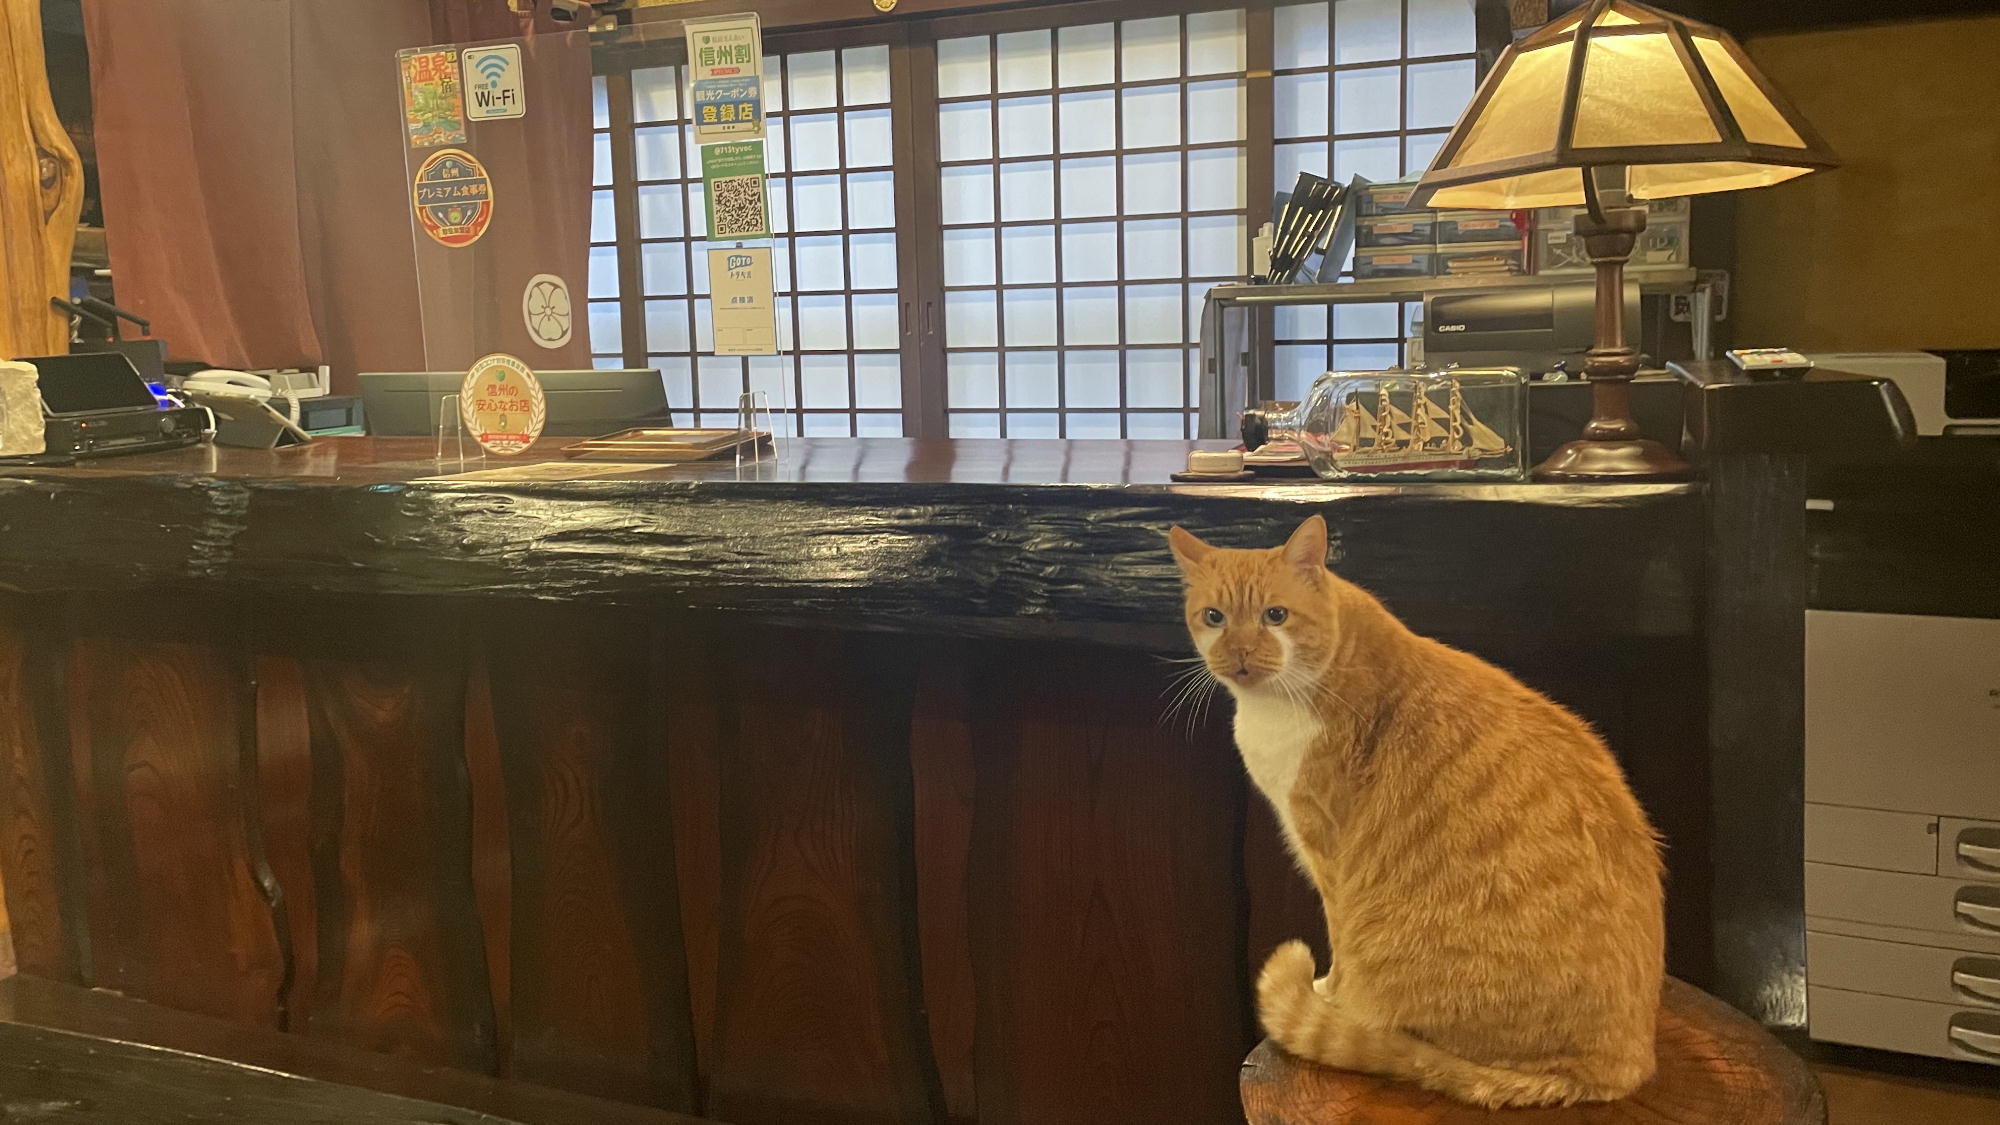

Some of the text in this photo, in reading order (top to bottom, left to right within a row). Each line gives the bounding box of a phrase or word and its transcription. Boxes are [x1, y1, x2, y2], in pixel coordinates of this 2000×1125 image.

[699, 43, 752, 67] 信州割
[475, 89, 516, 107] Wi-Fi
[702, 102, 754, 122] 登録店
[1439, 325, 1466, 333] CASIO
[486, 384, 519, 397] 信州の
[475, 399, 530, 412] 安心なお店
